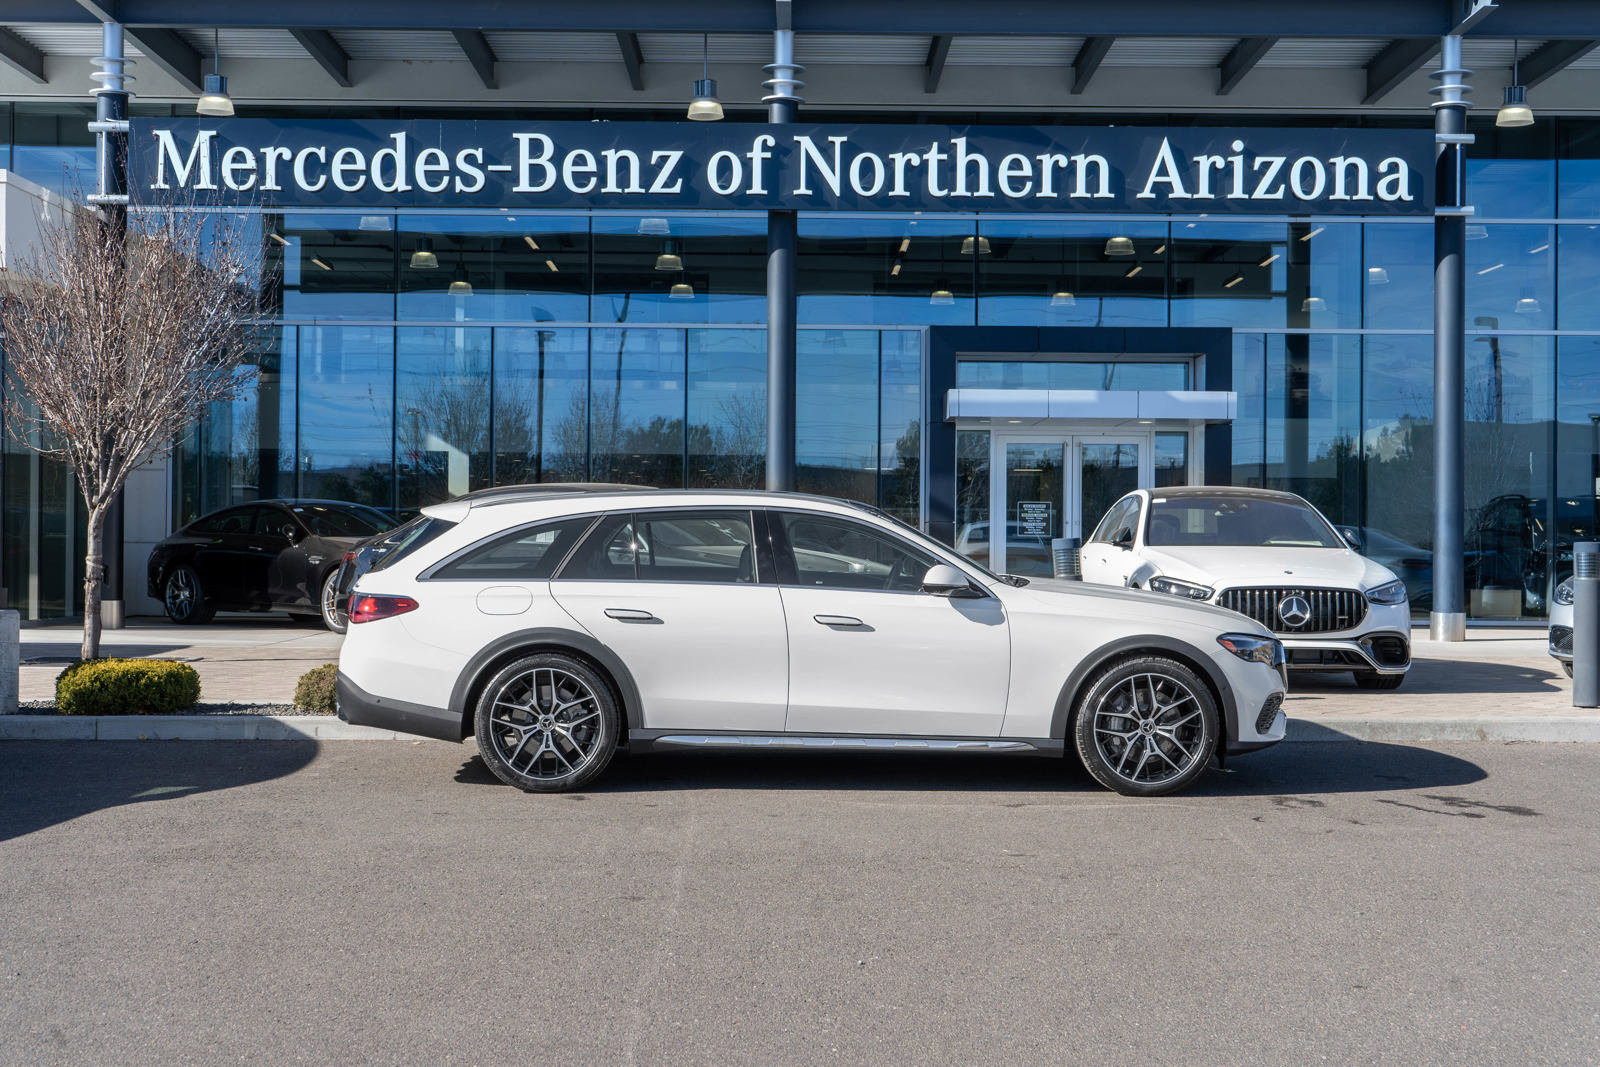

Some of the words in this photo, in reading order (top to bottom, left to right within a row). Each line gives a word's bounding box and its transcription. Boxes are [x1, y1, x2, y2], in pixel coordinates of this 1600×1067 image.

[150, 129, 685, 195] Mercedes-Benz
[706, 134, 777, 197] of
[792, 135, 1116, 199] Northern
[1136, 136, 1415, 202] Arizona
